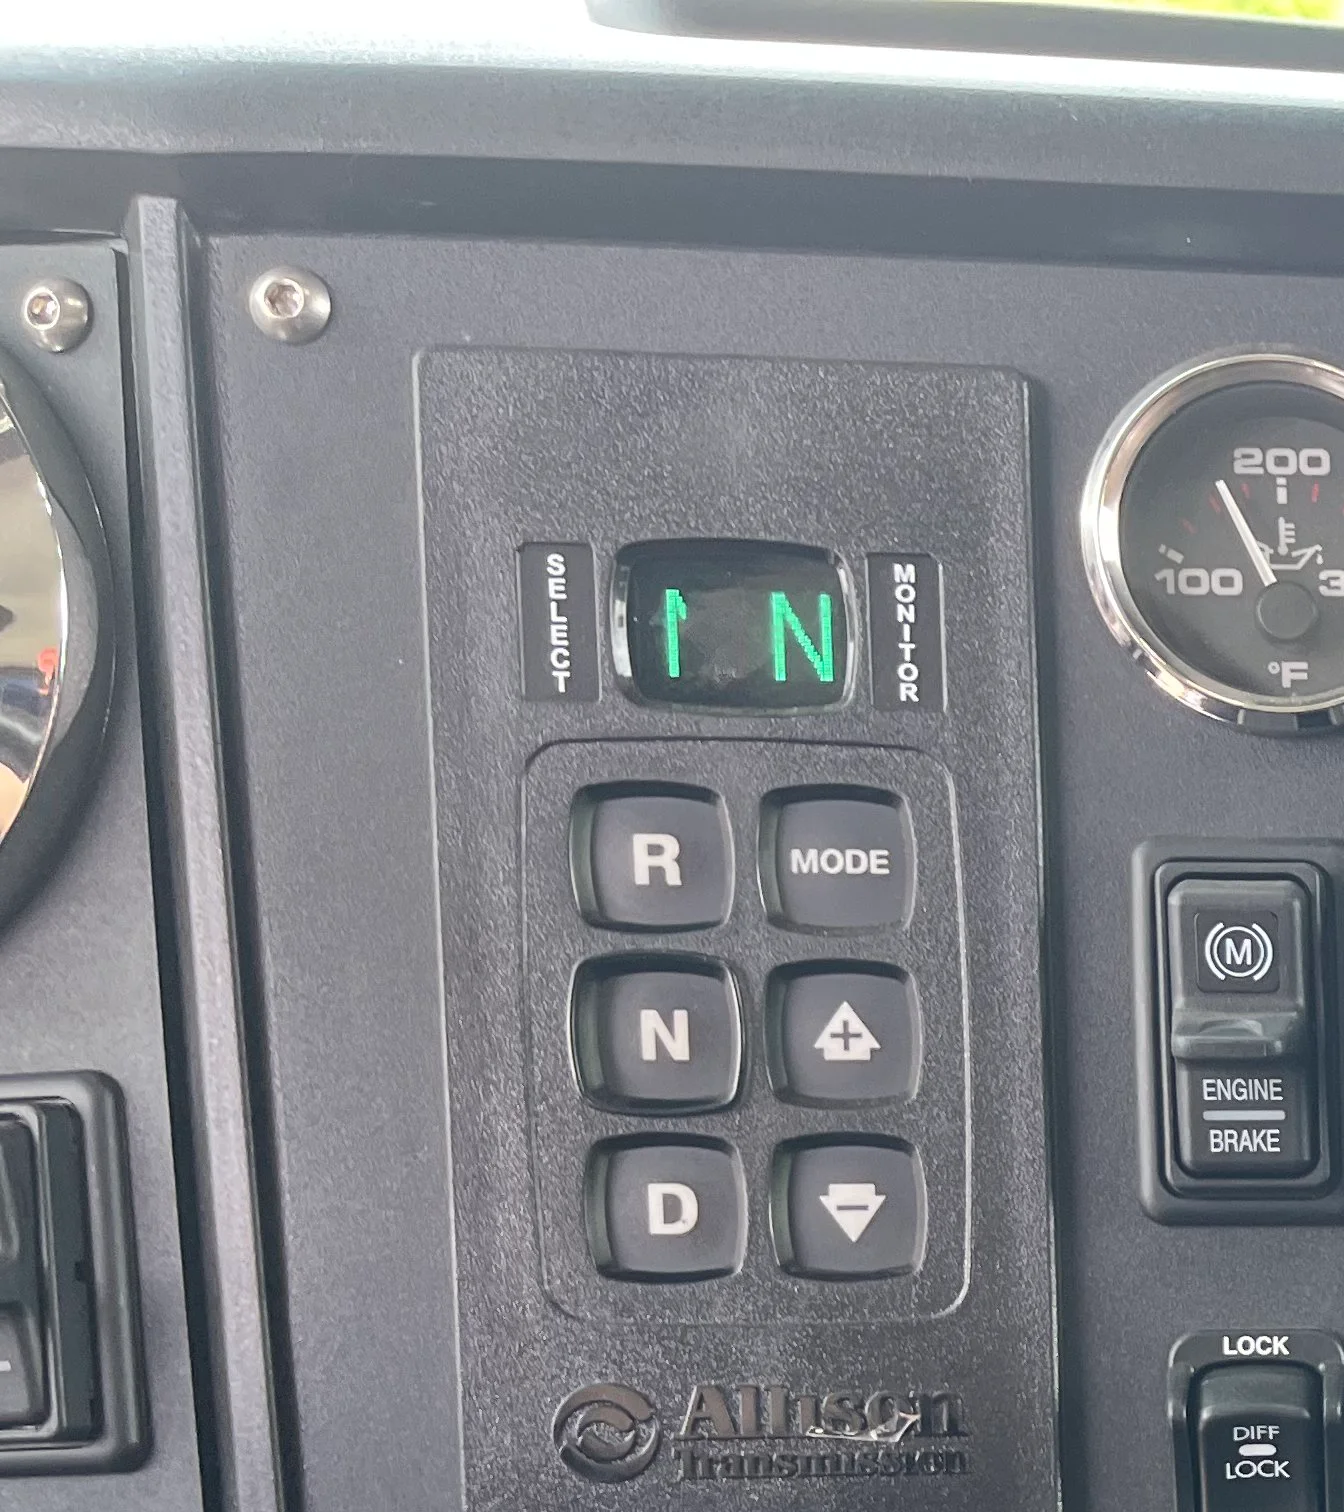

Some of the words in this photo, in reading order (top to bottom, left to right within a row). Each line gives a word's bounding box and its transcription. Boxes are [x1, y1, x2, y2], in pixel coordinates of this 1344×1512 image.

[1233, 447, 1331, 476] 200
[1154, 567, 1244, 596] 100
[545, 552, 572, 693] SELECT
[771, 591, 834, 682] N
[892, 562, 919, 702] MONITOR
[632, 833, 683, 886] R
[790, 848, 890, 876] MODE
[639, 1008, 691, 1061] N
[1202, 1077, 1284, 1102] ENGINE
[1209, 1128, 1281, 1153] BRAKE
[647, 1183, 699, 1237] D
[1222, 1335, 1291, 1357] LOCK
[1232, 1424, 1281, 1442] DIFF
[1225, 1459, 1291, 1481] LOCK
